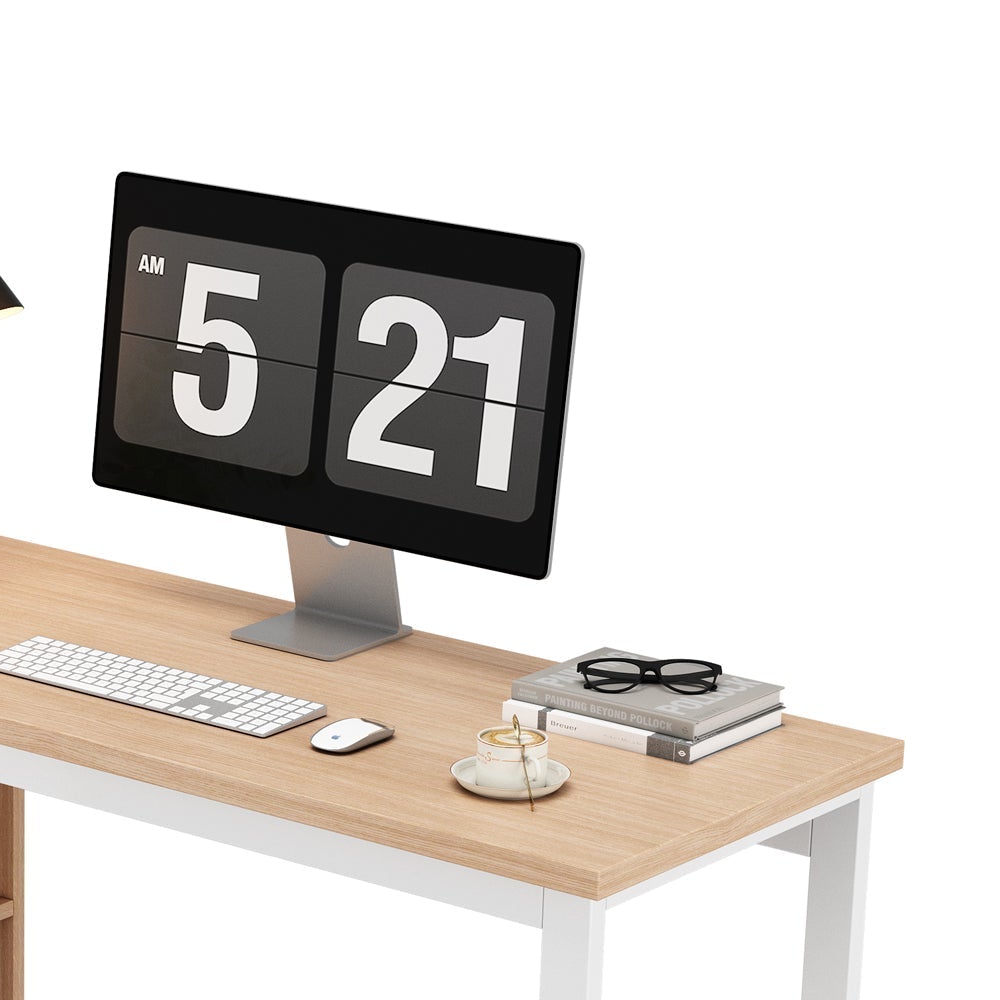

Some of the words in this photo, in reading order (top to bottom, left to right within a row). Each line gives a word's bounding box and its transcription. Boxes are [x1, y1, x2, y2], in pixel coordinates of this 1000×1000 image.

[138, 254, 165, 276] AM
[171, 262, 260, 437] 5
[346, 295, 526, 492] 21
[544, 694, 588, 712] PAINTING
[590, 704, 627, 721] BEYOND
[630, 713, 673, 732] POLLOCK
